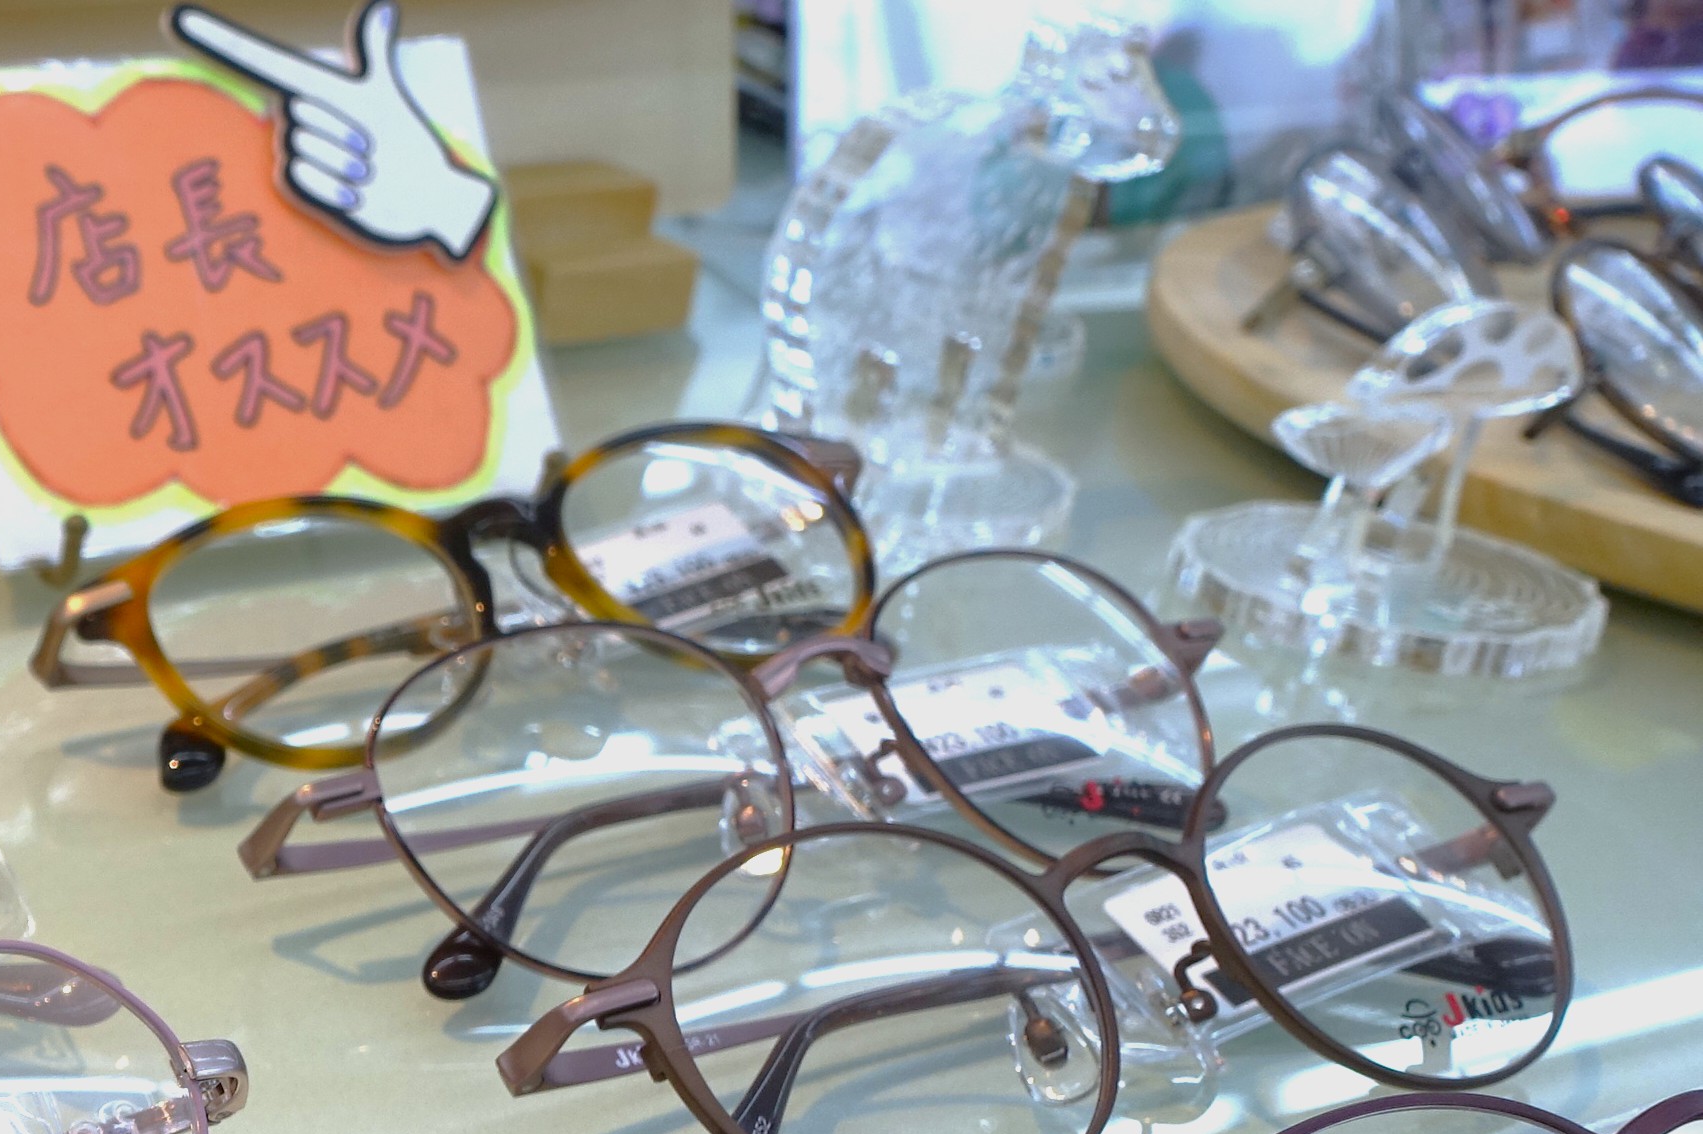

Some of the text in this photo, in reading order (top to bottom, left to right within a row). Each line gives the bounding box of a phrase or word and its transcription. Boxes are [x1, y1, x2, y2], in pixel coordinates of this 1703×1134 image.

[28, 158, 282, 308] 店長
[112, 291, 457, 451] オススメ
